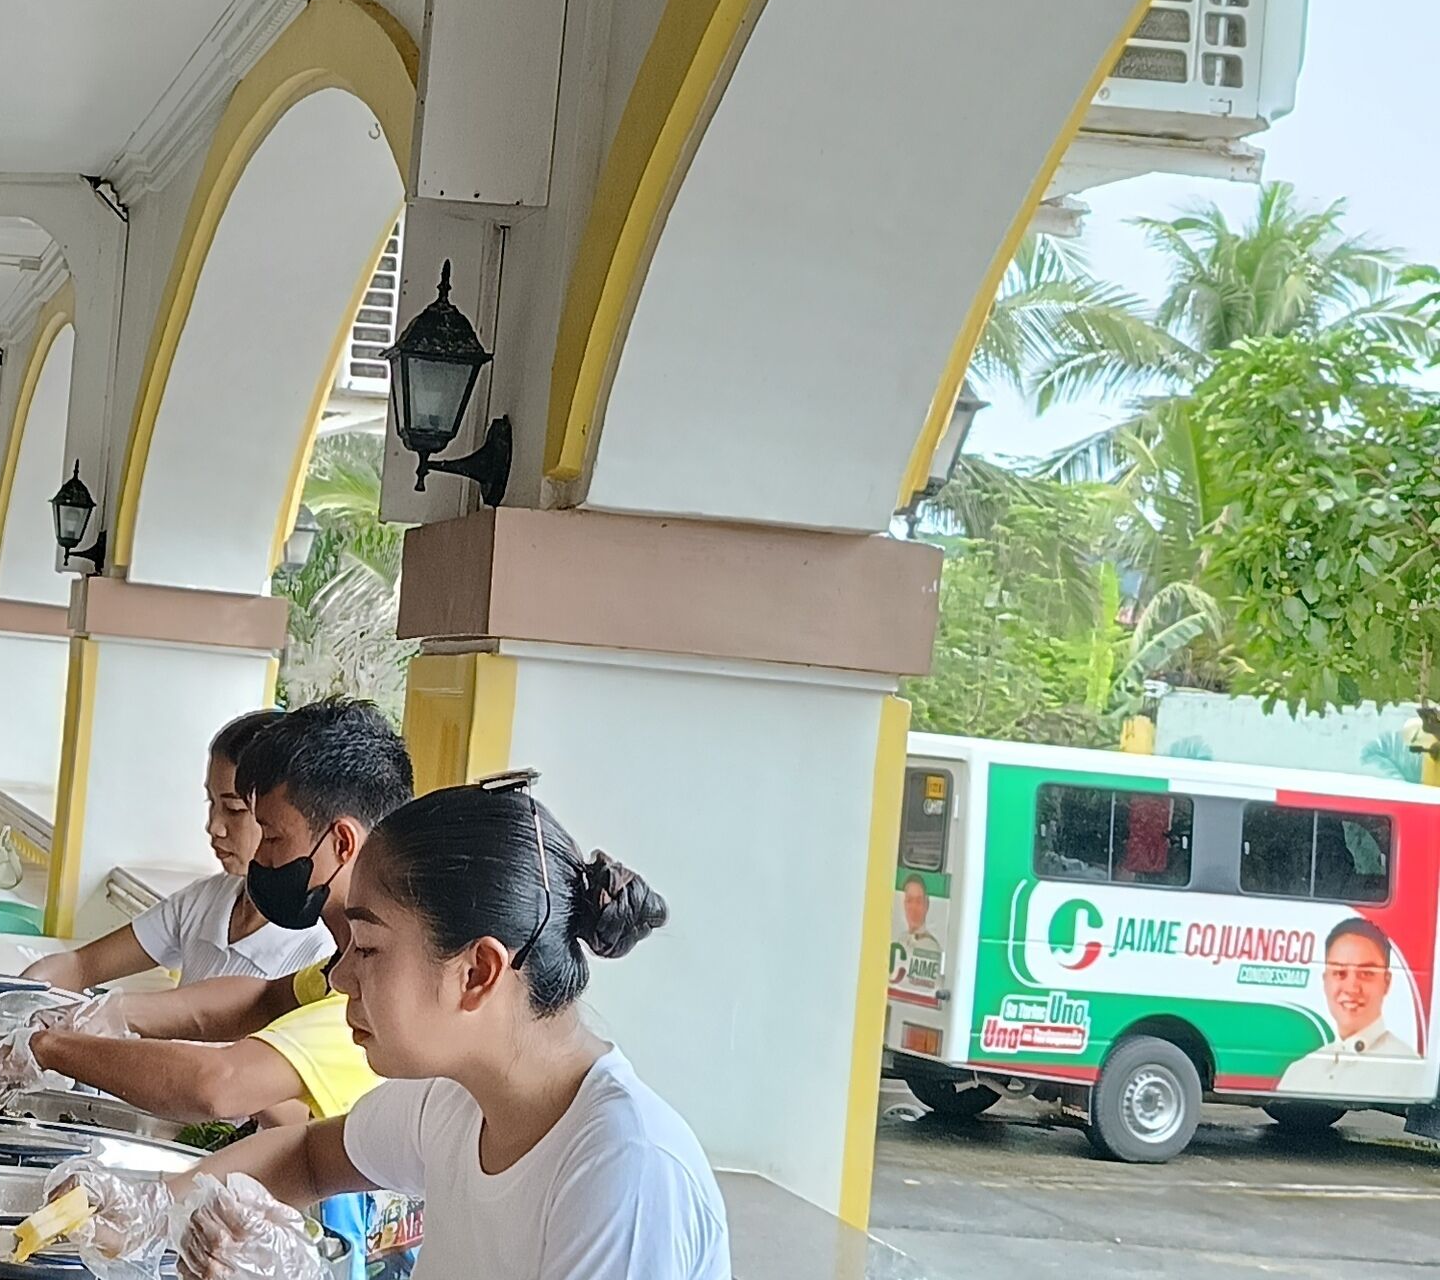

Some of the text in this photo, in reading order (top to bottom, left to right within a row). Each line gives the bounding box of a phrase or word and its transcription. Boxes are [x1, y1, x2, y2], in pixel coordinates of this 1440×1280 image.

[1108, 917, 1316, 966] JAIME COJUANGCO
[983, 1019, 1020, 1049] Una
